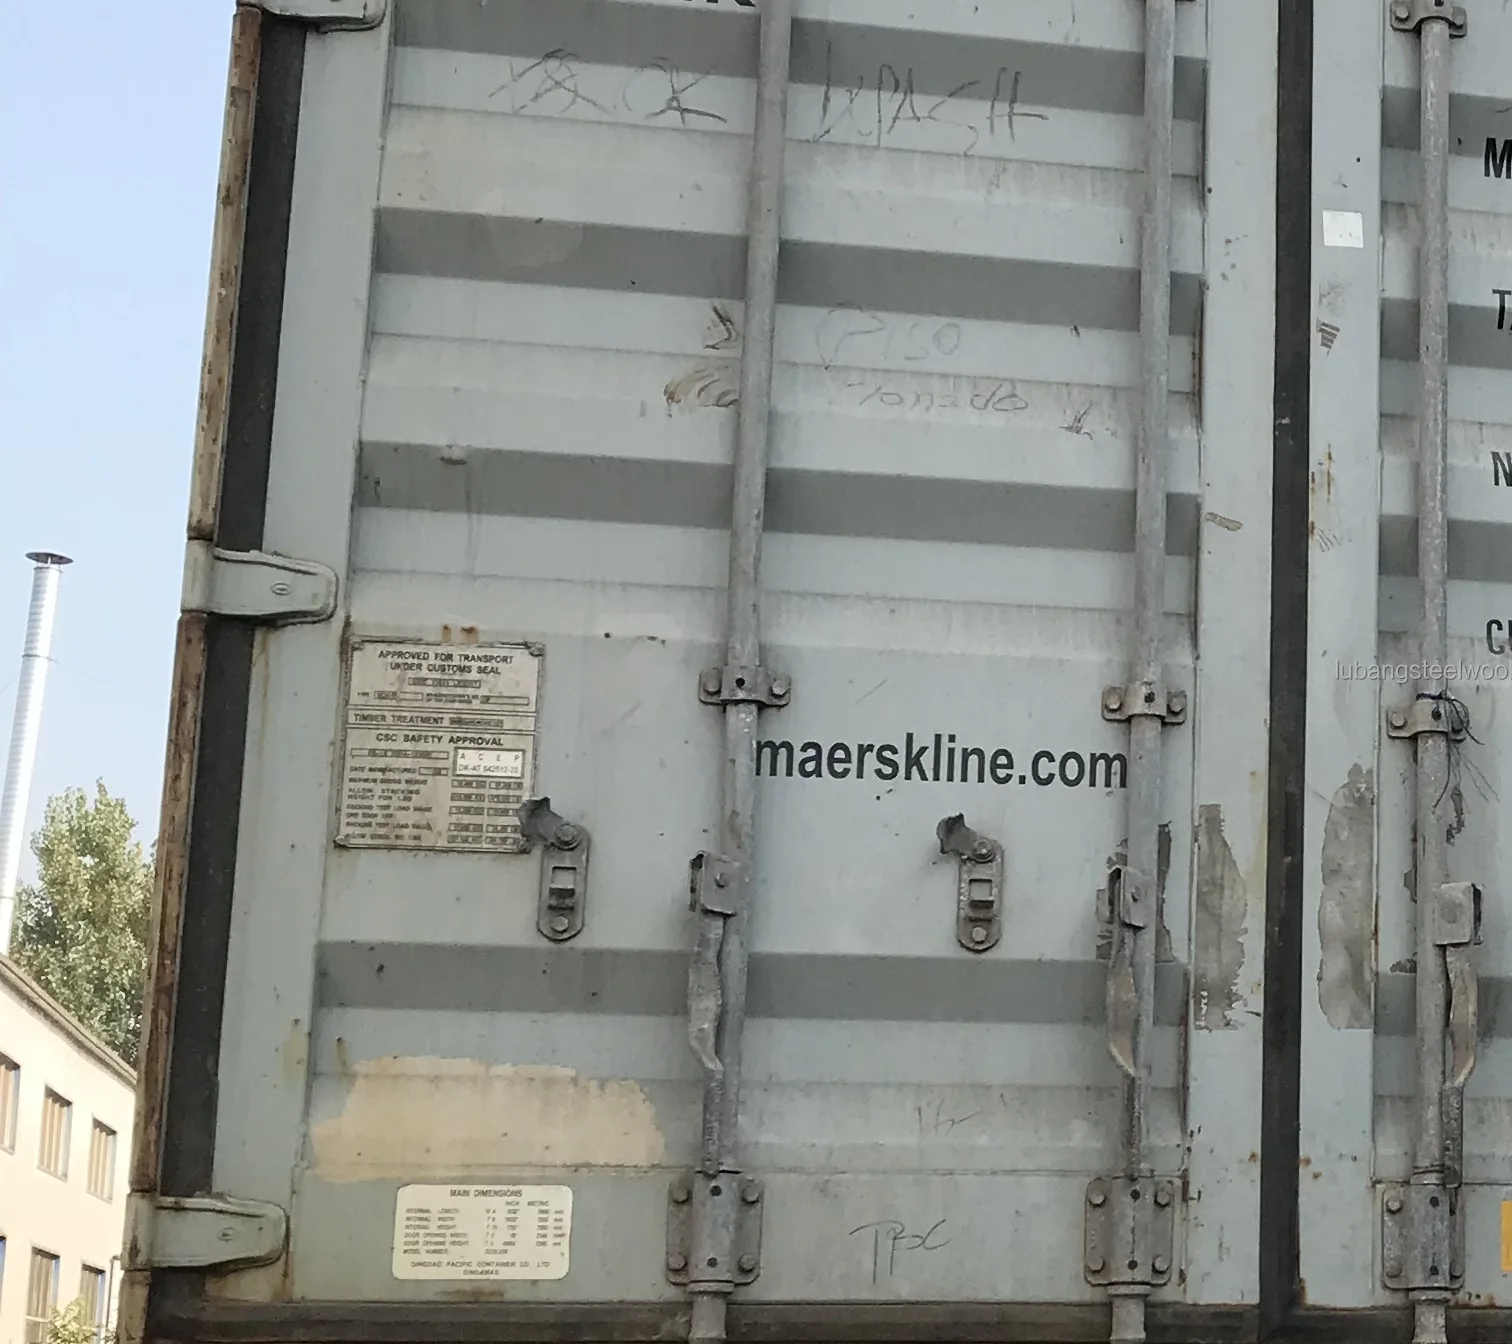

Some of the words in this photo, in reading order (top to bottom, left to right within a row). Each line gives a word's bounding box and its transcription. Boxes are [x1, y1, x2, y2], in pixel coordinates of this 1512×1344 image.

[378, 651, 429, 661] APPROVED
[458, 653, 514, 664] TRANSPORT
[390, 662, 423, 672] UNDER
[477, 665, 501, 674] SEAL
[376, 733, 398, 743] CSC
[403, 734, 443, 745] SAFETY
[448, 736, 504, 746] APPROVAL
[755, 732, 1128, 789] maerskline.com
[474, 1189, 523, 1198] DIMENSIONS
